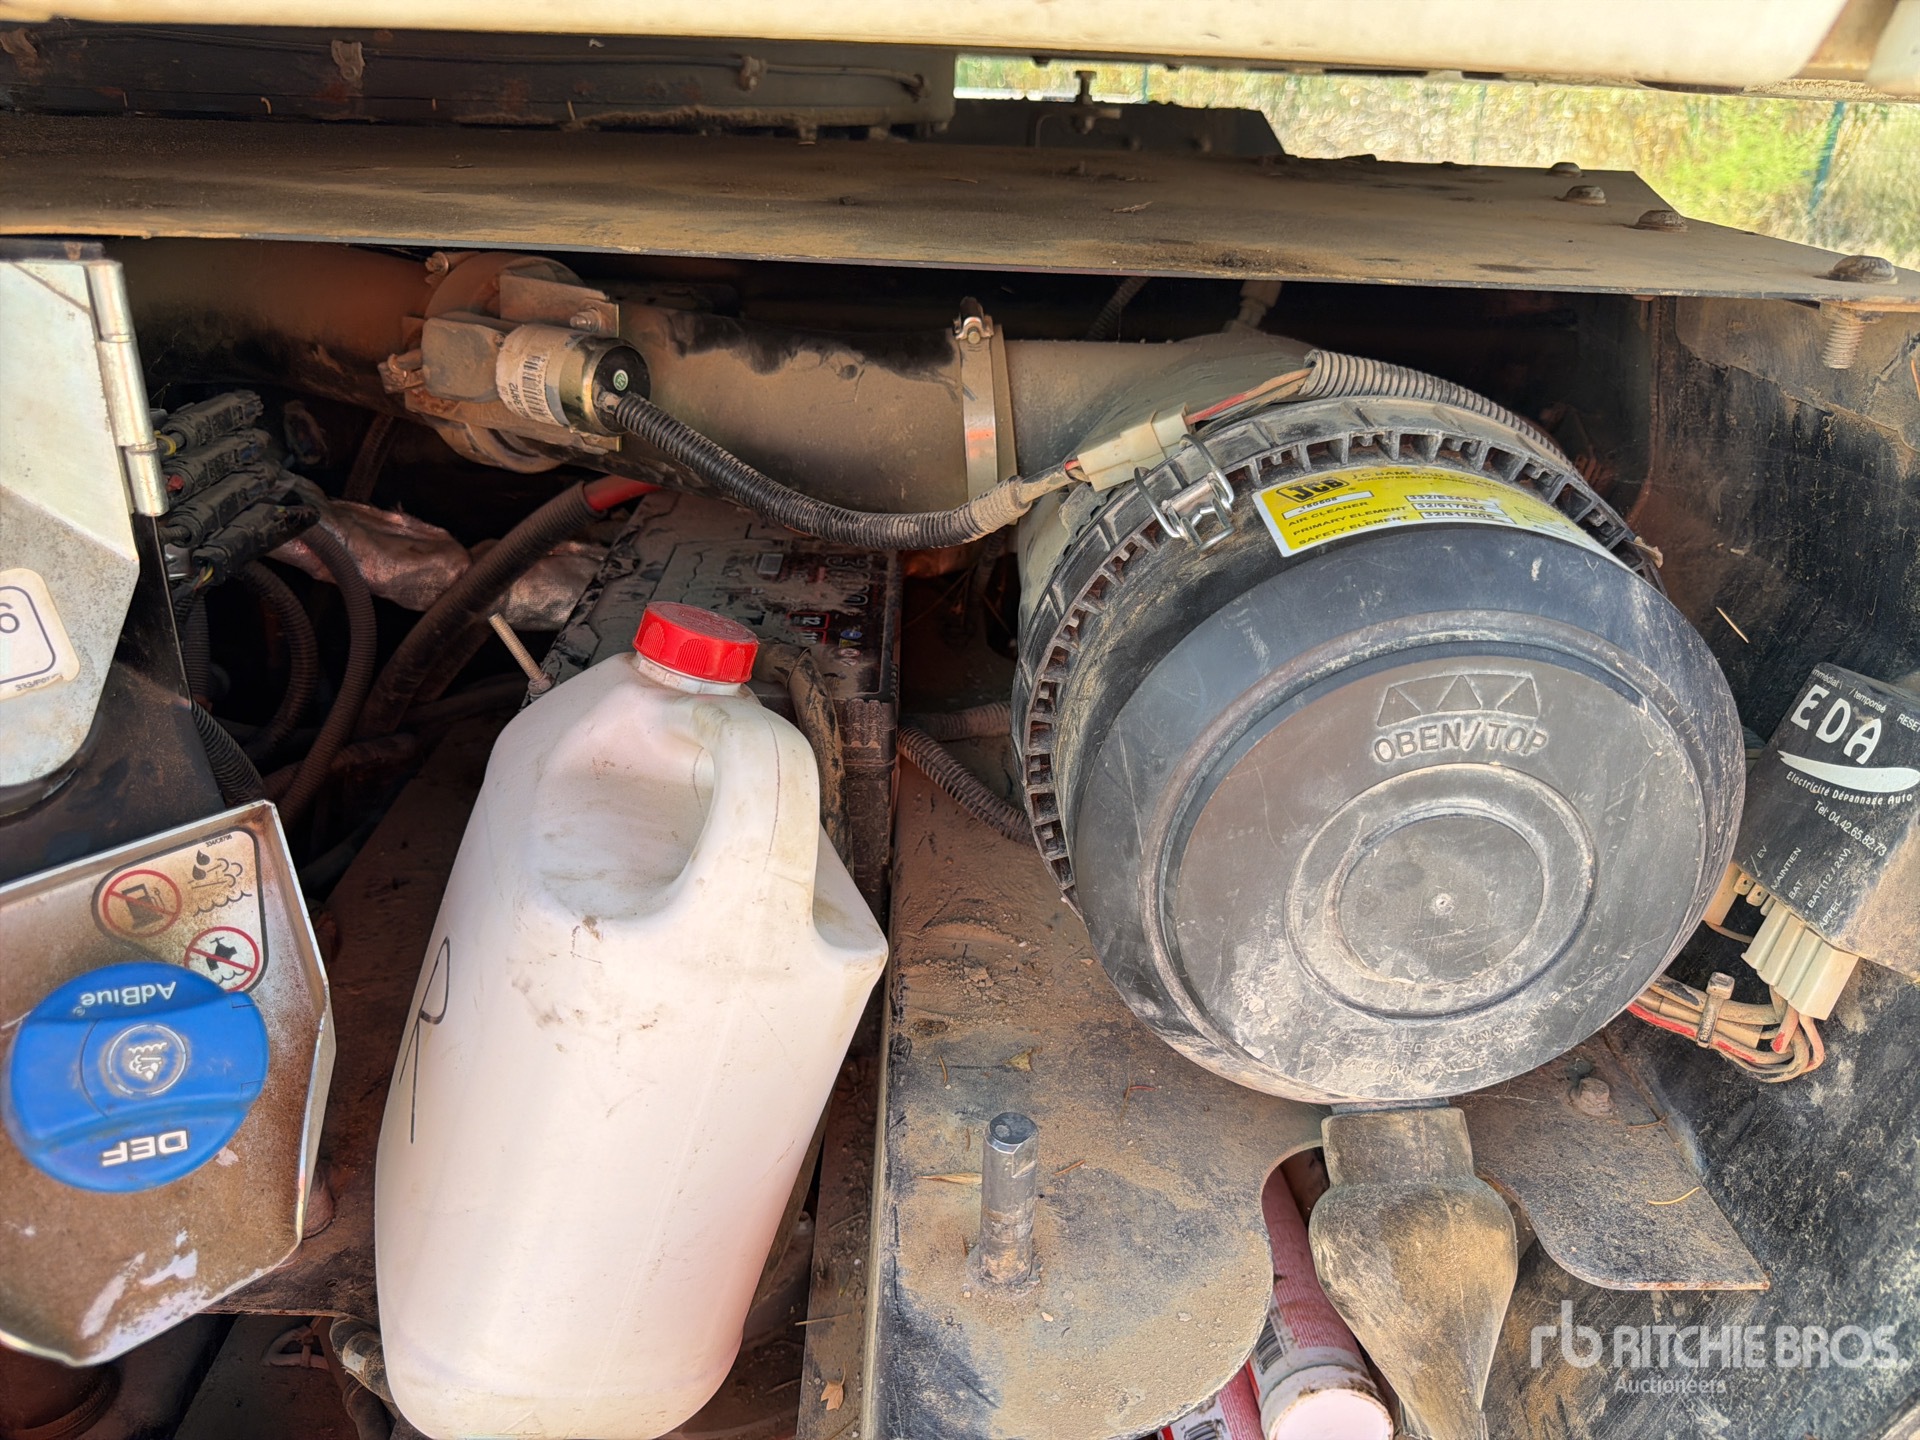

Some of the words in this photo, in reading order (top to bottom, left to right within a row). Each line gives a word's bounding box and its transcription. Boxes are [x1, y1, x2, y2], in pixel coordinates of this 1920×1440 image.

[1287, 479, 1344, 500] JCB
[1288, 516, 1309, 526] AIR
[1311, 501, 1369, 518] CLEANER
[1292, 515, 1347, 536] PRIMARY
[1349, 505, 1408, 519] ELEMENT
[1298, 526, 1346, 544] SAFETY
[1349, 514, 1409, 529] ELEMENT
[1853, 689, 1888, 714] temporisé
[1790, 684, 1882, 765] EDA
[1374, 720, 1549, 763] OBEN/TOP
[1785, 771, 1830, 798] Electricité
[1832, 787, 1884, 807] Dépannage
[1887, 792, 1914, 806] Auto
[1813, 800, 1829, 818] Tel:
[1828, 810, 1888, 857] 04.42.65.82.73
[1756, 844, 1768, 860] EV
[1770, 846, 1802, 891] MAINTIEN
[1819, 899, 1843, 930] APPEL
[80, 981, 177, 1007] AdBlue
[102, 1130, 189, 1168] DEF
